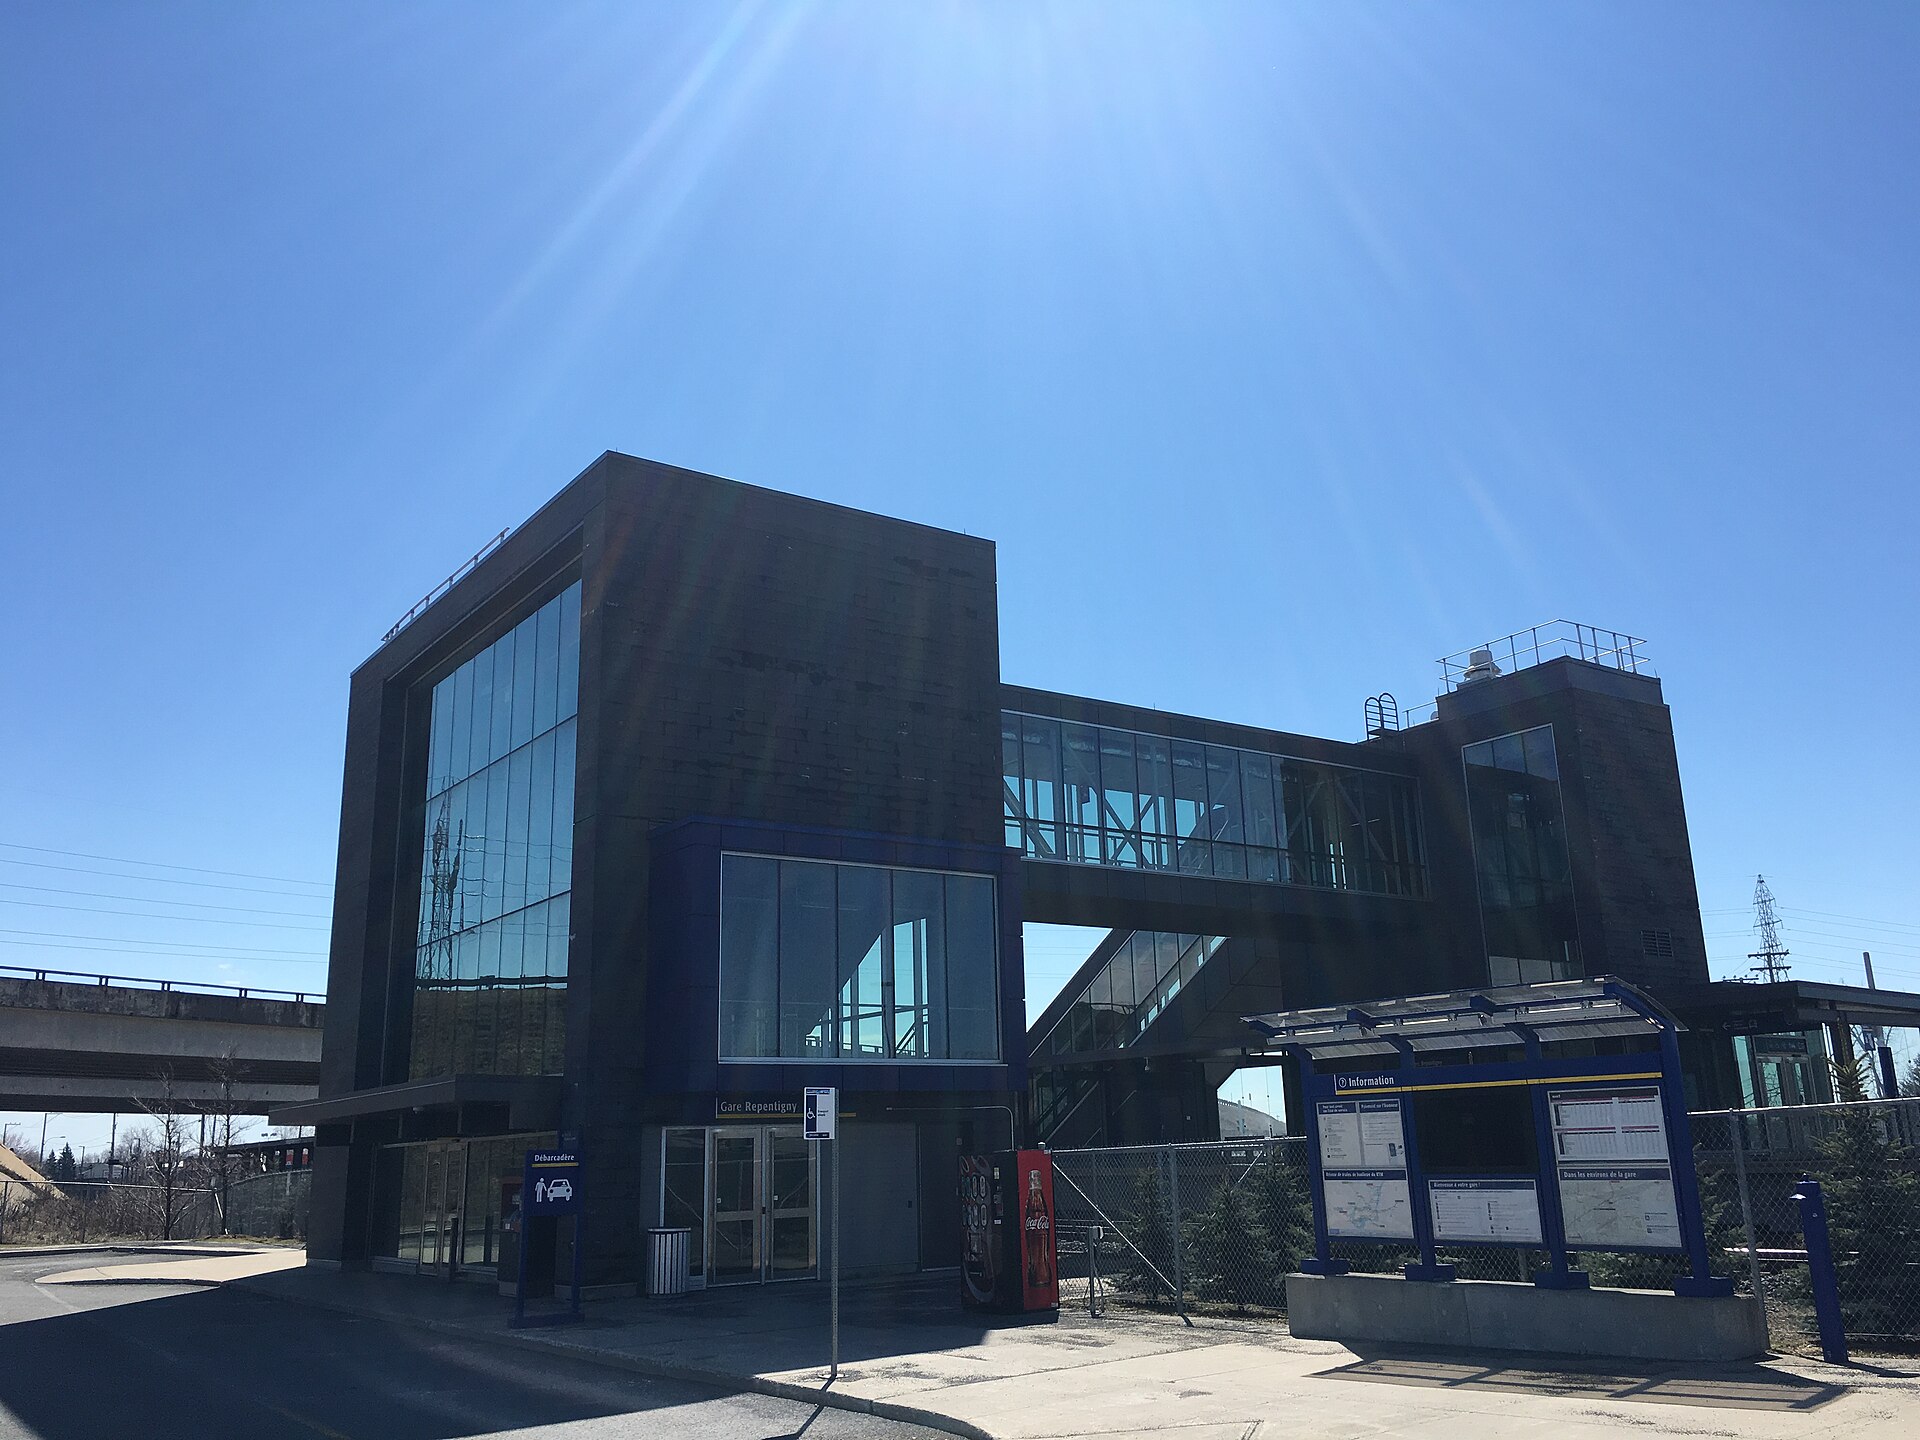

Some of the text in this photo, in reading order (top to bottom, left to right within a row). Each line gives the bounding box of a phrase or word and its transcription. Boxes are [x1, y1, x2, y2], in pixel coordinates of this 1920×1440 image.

[1348, 1075, 1395, 1087] Information
[720, 1100, 797, 1113] Gare Repentigny
[534, 1154, 575, 1162] Débarcadère
